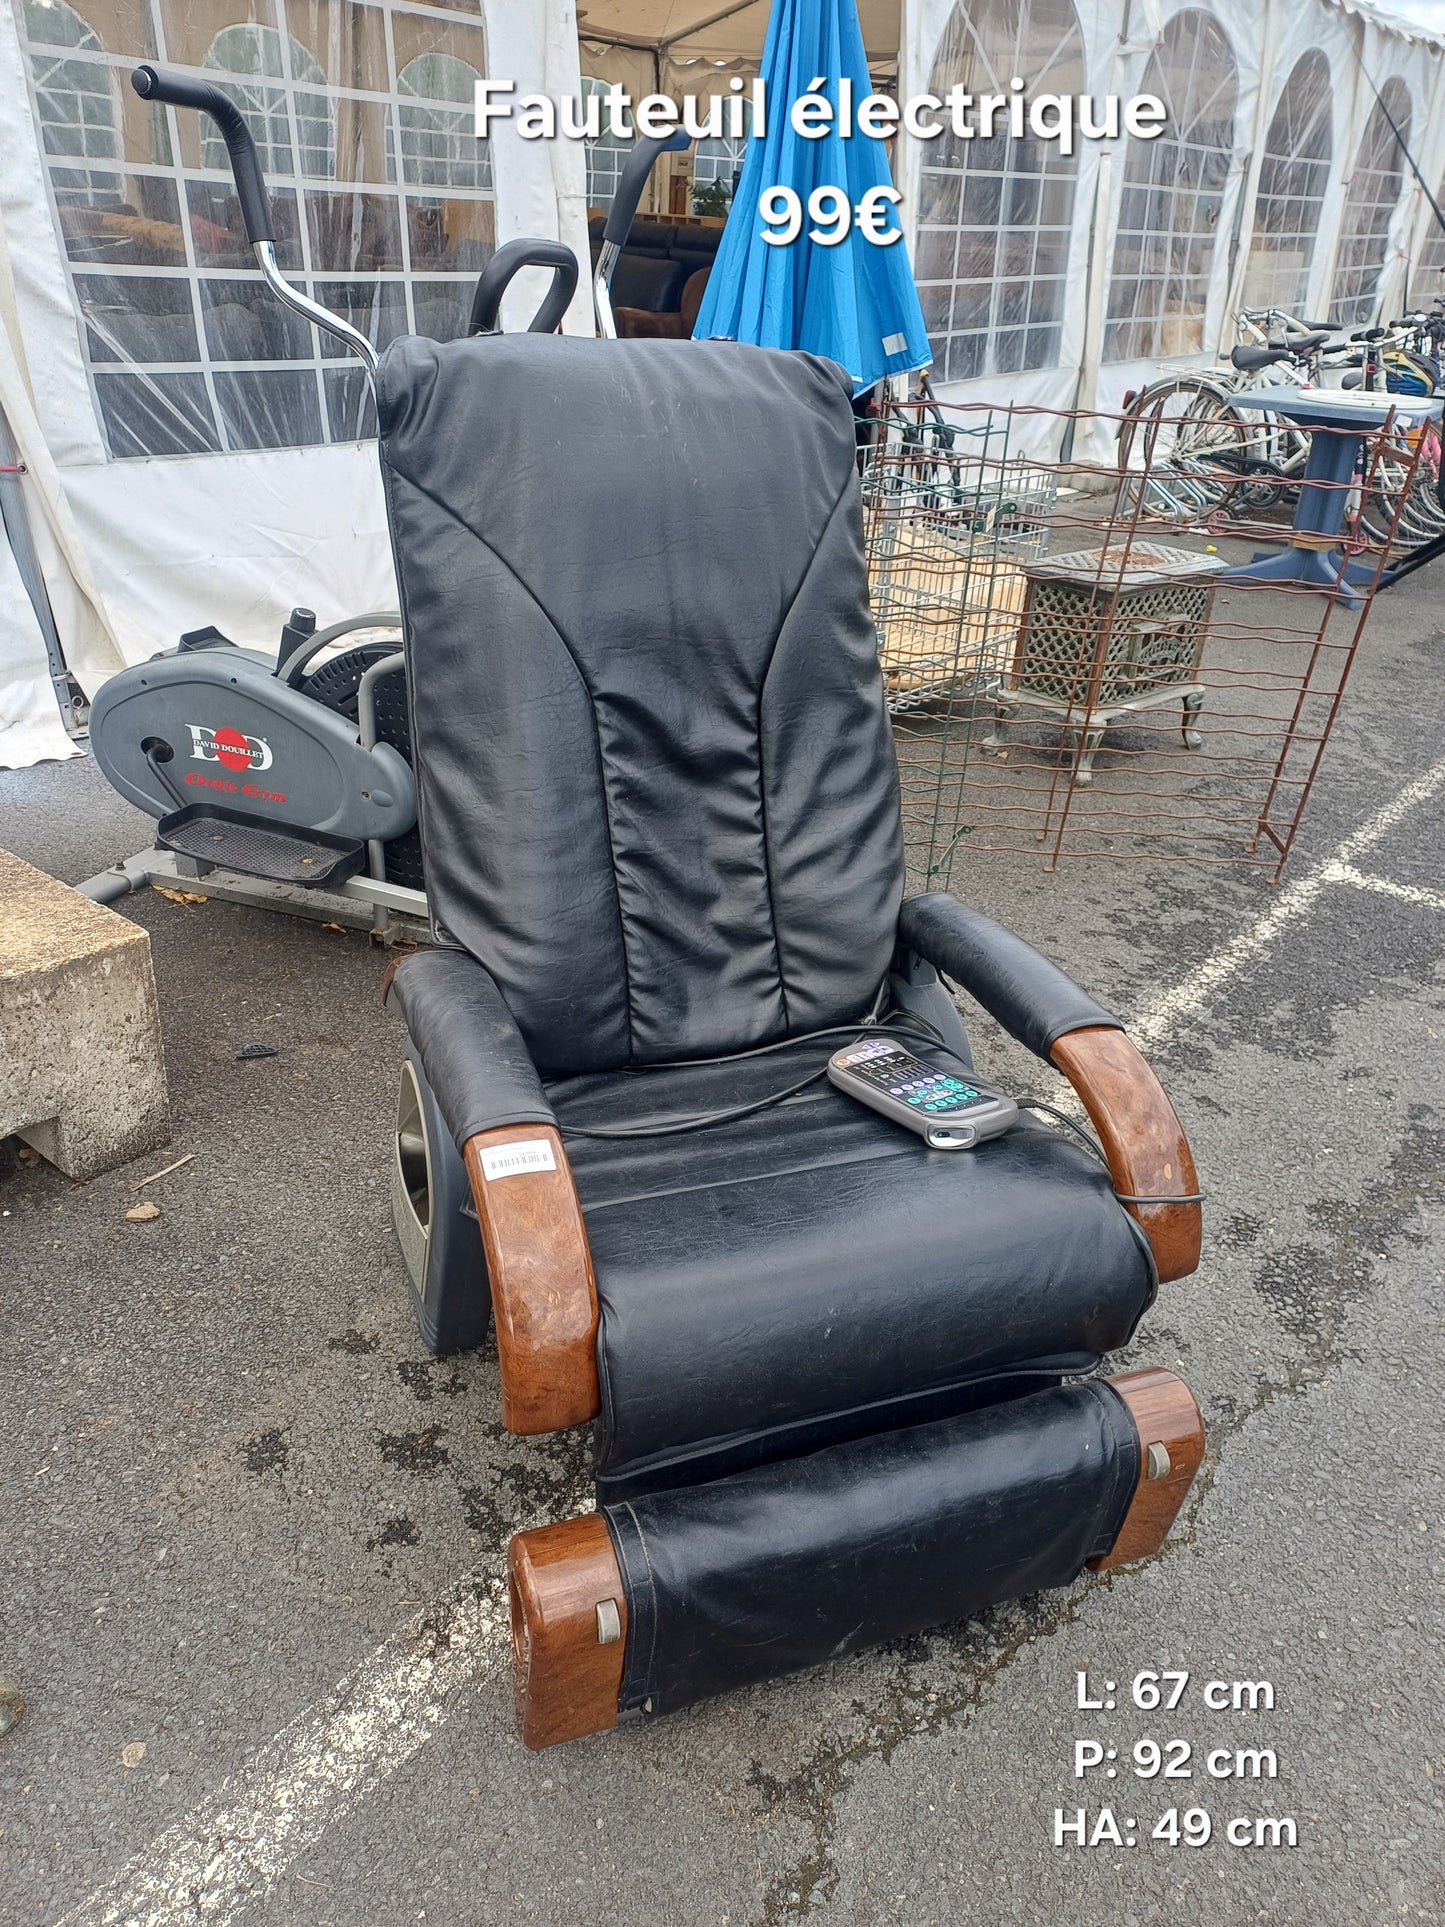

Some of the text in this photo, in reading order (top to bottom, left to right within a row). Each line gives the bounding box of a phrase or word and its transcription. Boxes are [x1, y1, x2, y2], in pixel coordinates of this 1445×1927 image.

[193, 739, 264, 759] DAVID DOUILLET
[185, 773, 286, 803] Orbit Gym
